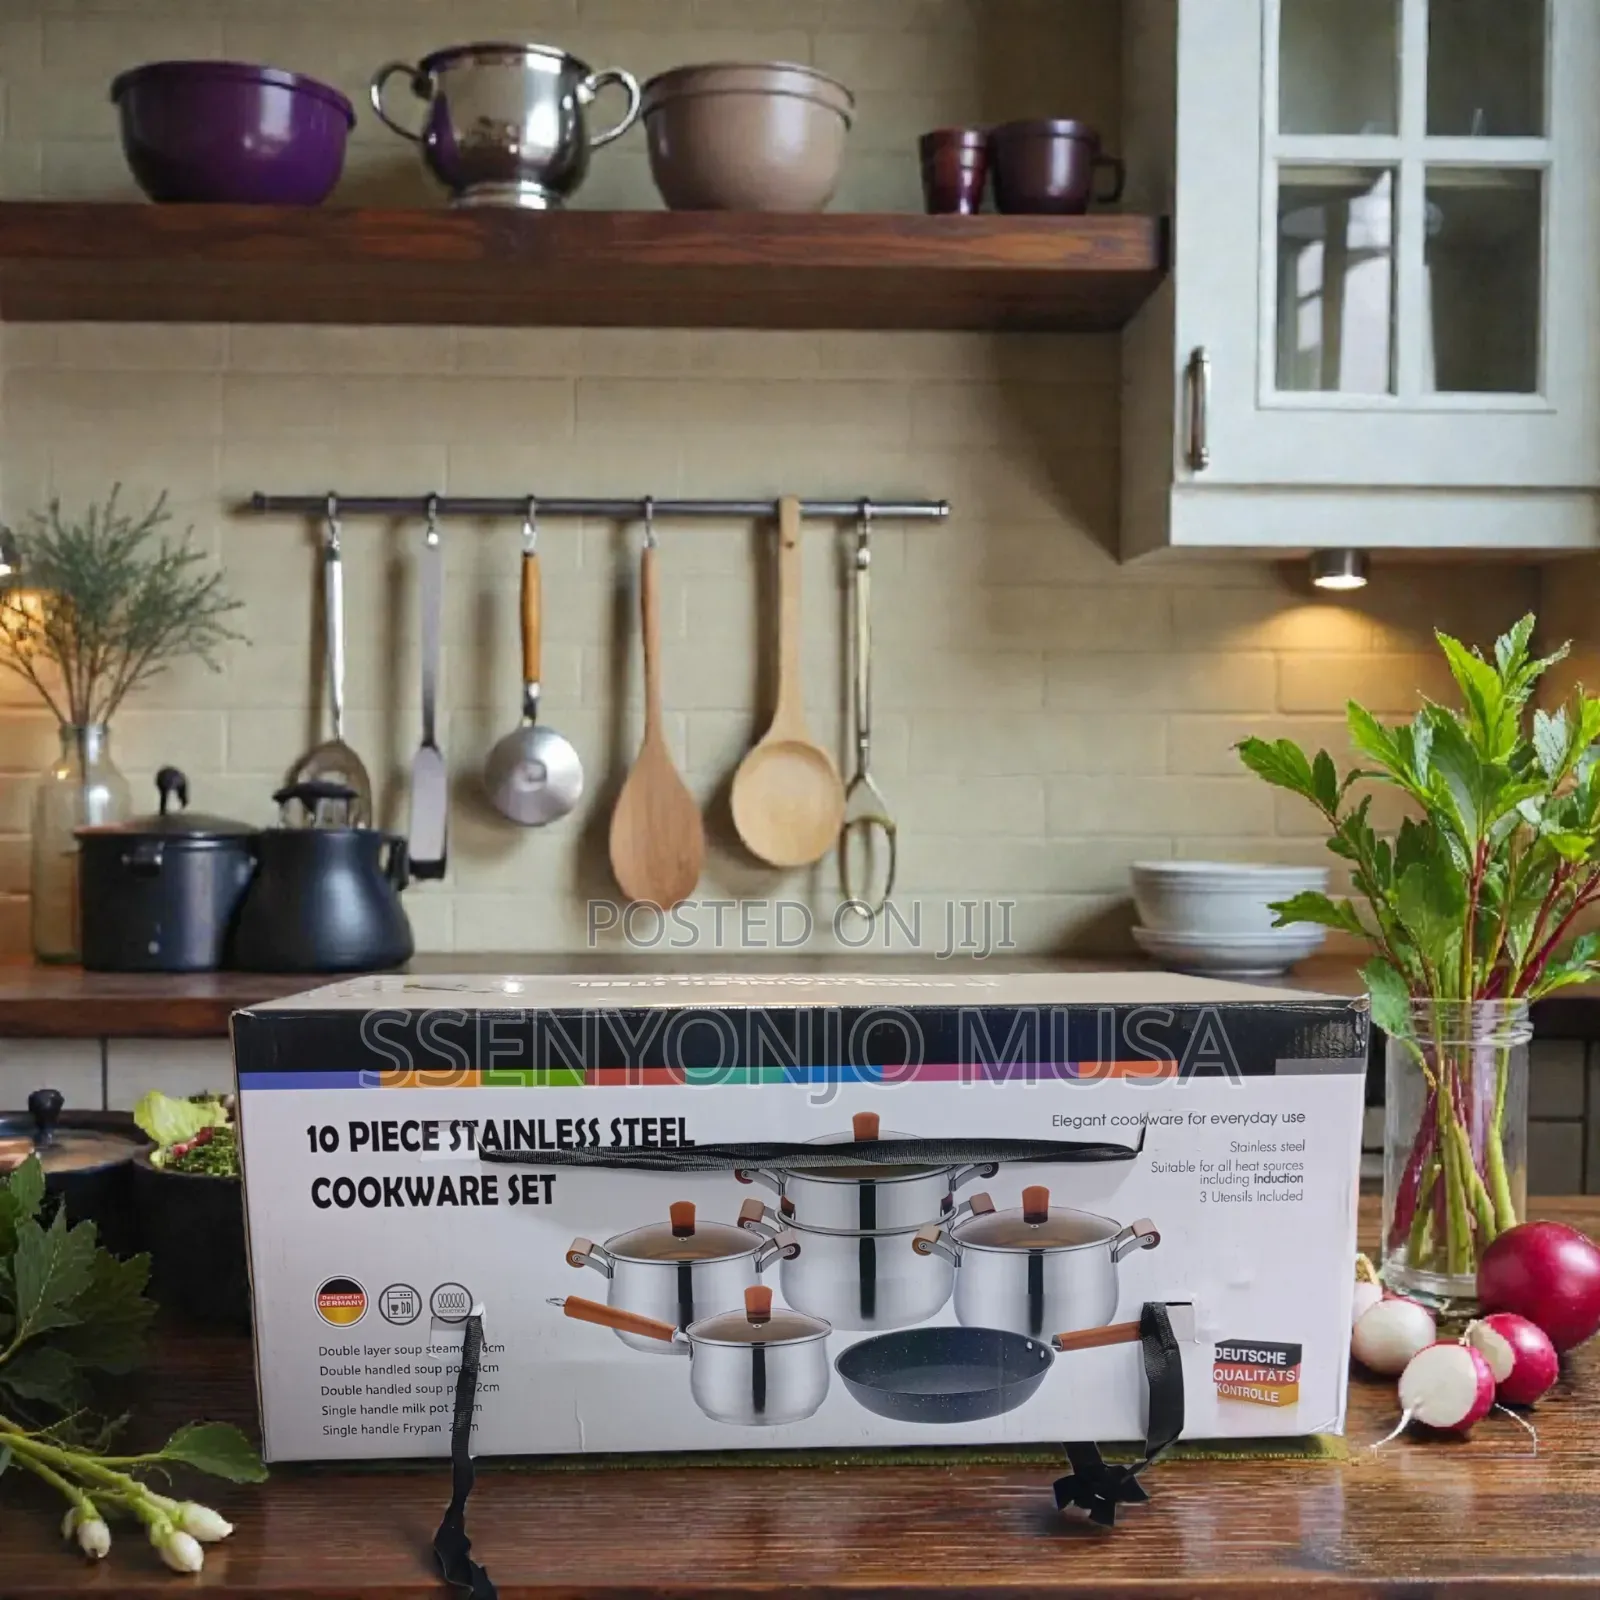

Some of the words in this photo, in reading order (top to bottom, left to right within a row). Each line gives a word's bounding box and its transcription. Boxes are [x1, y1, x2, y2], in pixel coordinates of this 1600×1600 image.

[1052, 1114, 1107, 1129] Elegant
[1110, 1112, 1183, 1126] cookware
[1188, 1113, 1208, 1125] for
[1210, 1112, 1278, 1127] everyday
[1281, 1113, 1306, 1123] use
[307, 1125, 339, 1153] 10
[349, 1120, 440, 1152] PIECE
[450, 1117, 600, 1152] STAINLESS
[610, 1117, 695, 1148] STEEL
[1230, 1141, 1278, 1152] Stainless
[1280, 1139, 1306, 1152] steel
[1151, 1161, 1196, 1173] Suitable
[1199, 1160, 1215, 1172] for
[1218, 1160, 1232, 1171] all
[1235, 1160, 1259, 1171] heat
[1262, 1161, 1304, 1171] sources
[1199, 1173, 1250, 1187] including
[1253, 1172, 1304, 1184] induction
[311, 1175, 499, 1209] COOKWARE
[508, 1174, 556, 1206] SET
[1199, 1191, 1208, 1202] 3
[1211, 1190, 1253, 1202] Utensils
[1256, 1190, 1303, 1202] Included
[318, 1345, 360, 1356] Double
[363, 1345, 391, 1358] layer
[394, 1345, 422, 1357] soup
[1214, 1347, 1287, 1365] DEUTSCHE
[320, 1365, 361, 1376] Double
[364, 1364, 411, 1375] handled
[414, 1365, 442, 1376] soup
[446, 1364, 463, 1376] po
[1213, 1367, 1296, 1382] QUALITÄTS
[321, 1385, 363, 1396] Double
[366, 1384, 412, 1395] handled
[415, 1385, 443, 1396] soup
[476, 1382, 500, 1392] 2cm
[1214, 1382, 1279, 1403] KONTROLLE
[322, 1405, 357, 1418] Single
[360, 1404, 399, 1415] handle
[402, 1403, 426, 1414] milk
[429, 1403, 449, 1415] pot
[323, 1425, 358, 1437] Single
[361, 1424, 400, 1435] handle
[403, 1423, 442, 1435] Frypan
